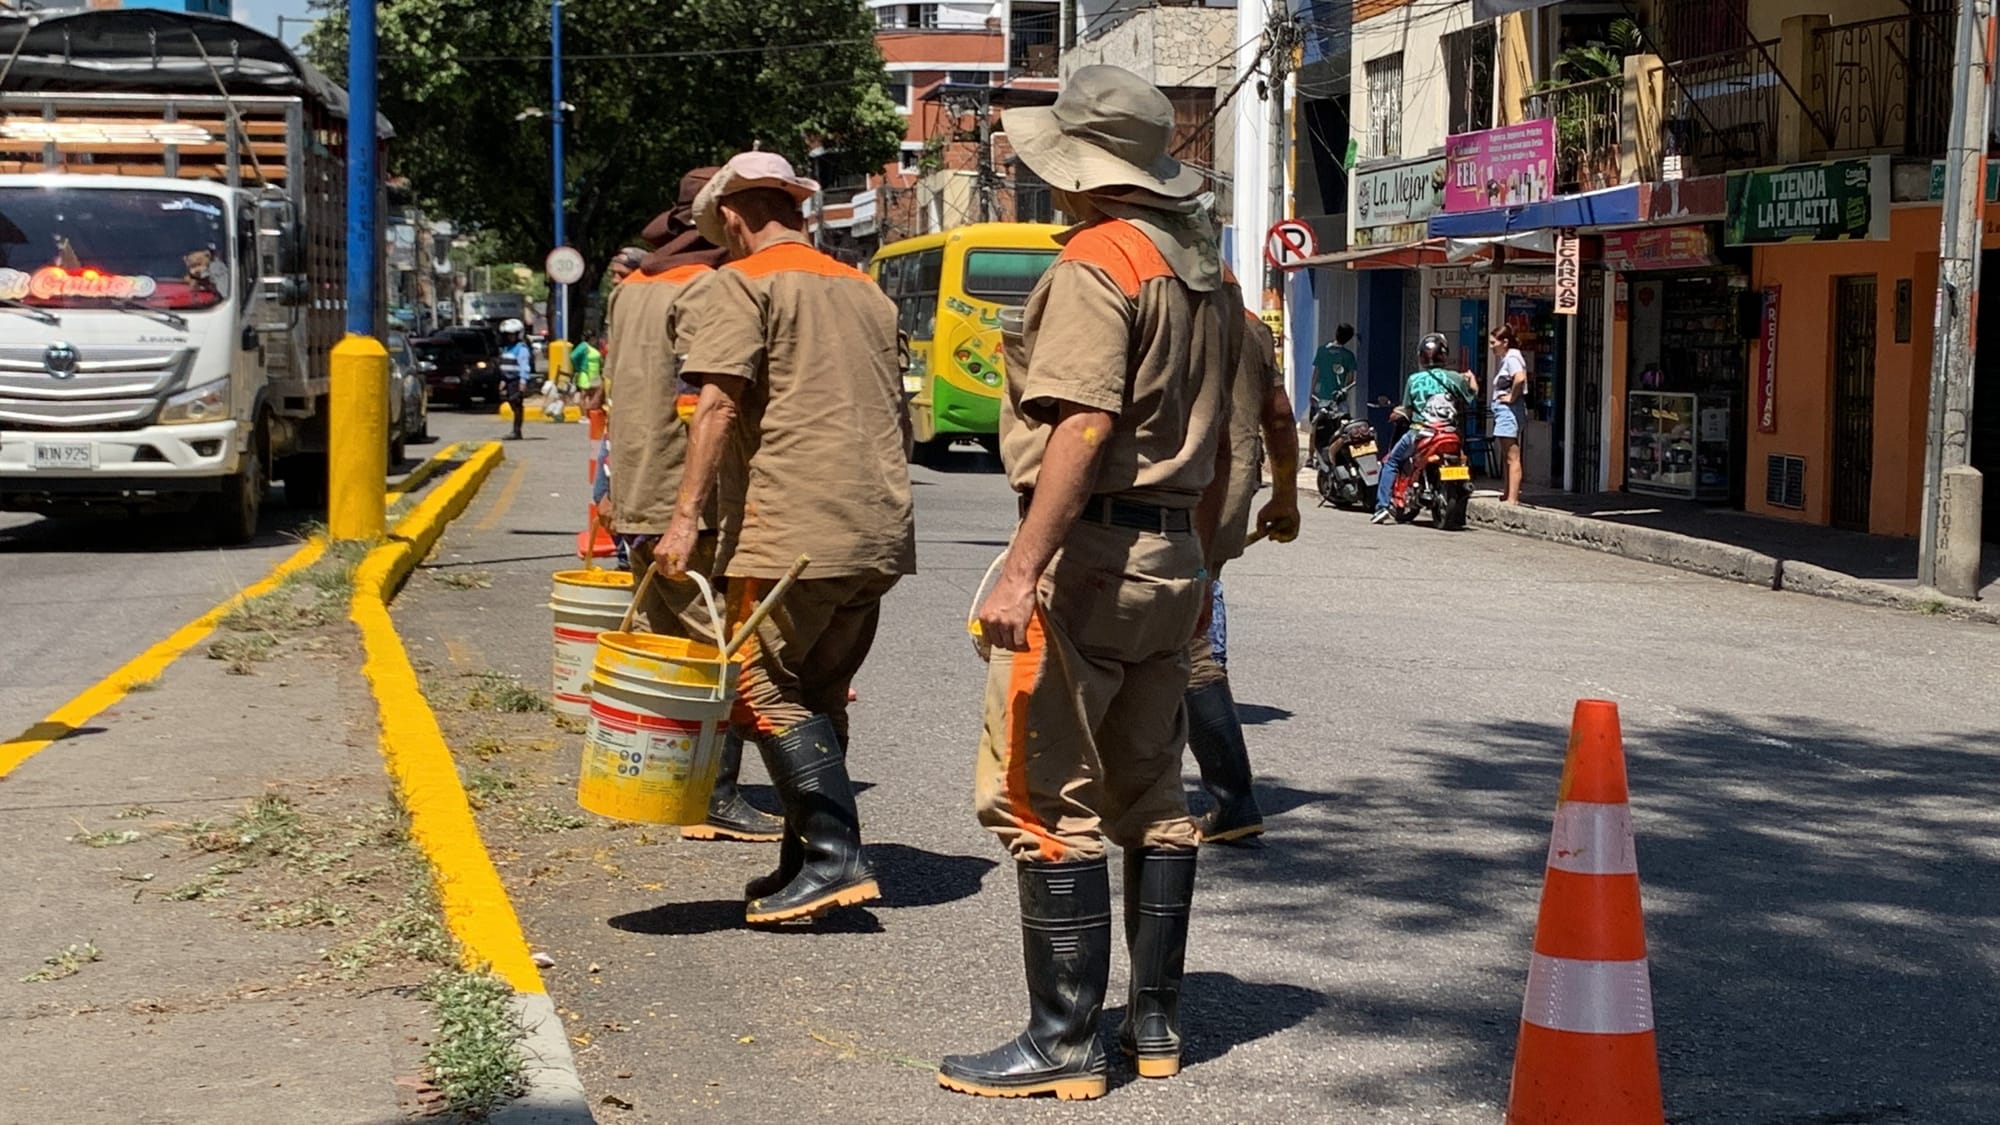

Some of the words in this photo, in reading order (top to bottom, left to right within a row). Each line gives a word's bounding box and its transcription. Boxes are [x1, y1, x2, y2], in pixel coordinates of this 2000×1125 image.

[1456, 161, 1477, 187] FER
[1769, 169, 1827, 201] TIENDA
[1373, 175, 1388, 206] La
[1391, 167, 1429, 219] Mejor
[1758, 203, 1775, 228] LA
[1776, 198, 1840, 227] PLACITA
[1281, 228, 1306, 263] P
[1558, 226, 1577, 309] RECARGAS
[1763, 307, 1777, 427] RECARGAS
[64, 447, 89, 461] 925
